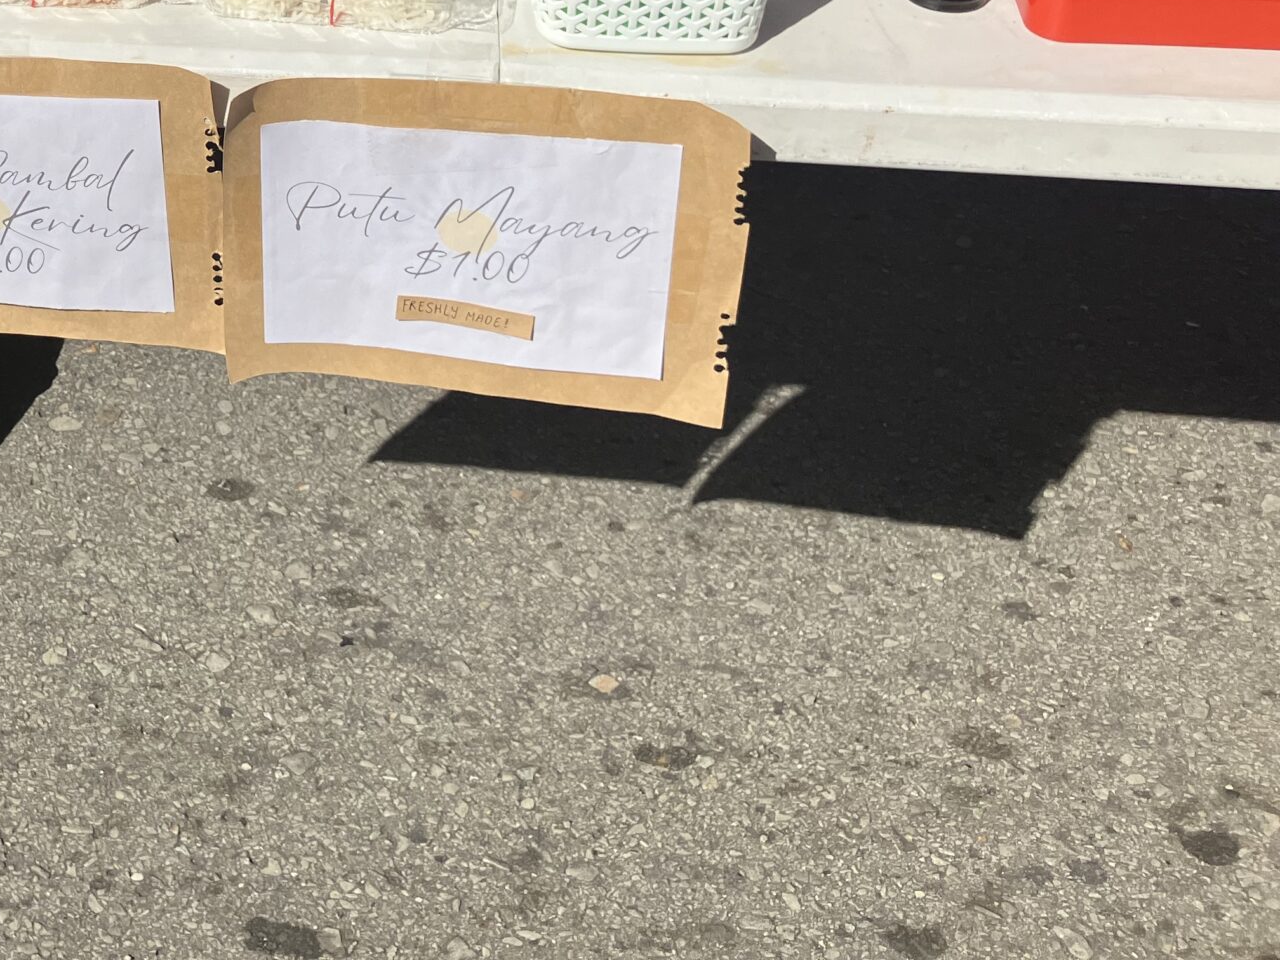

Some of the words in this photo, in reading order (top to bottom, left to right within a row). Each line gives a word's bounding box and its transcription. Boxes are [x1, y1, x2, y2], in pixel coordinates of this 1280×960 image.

[286, 181, 415, 238] Putu
[434, 185, 658, 263] Mayang
[404, 242, 529, 284] $1.00
[401, 297, 459, 320] FRESHLY
[465, 310, 510, 330] MADE!
